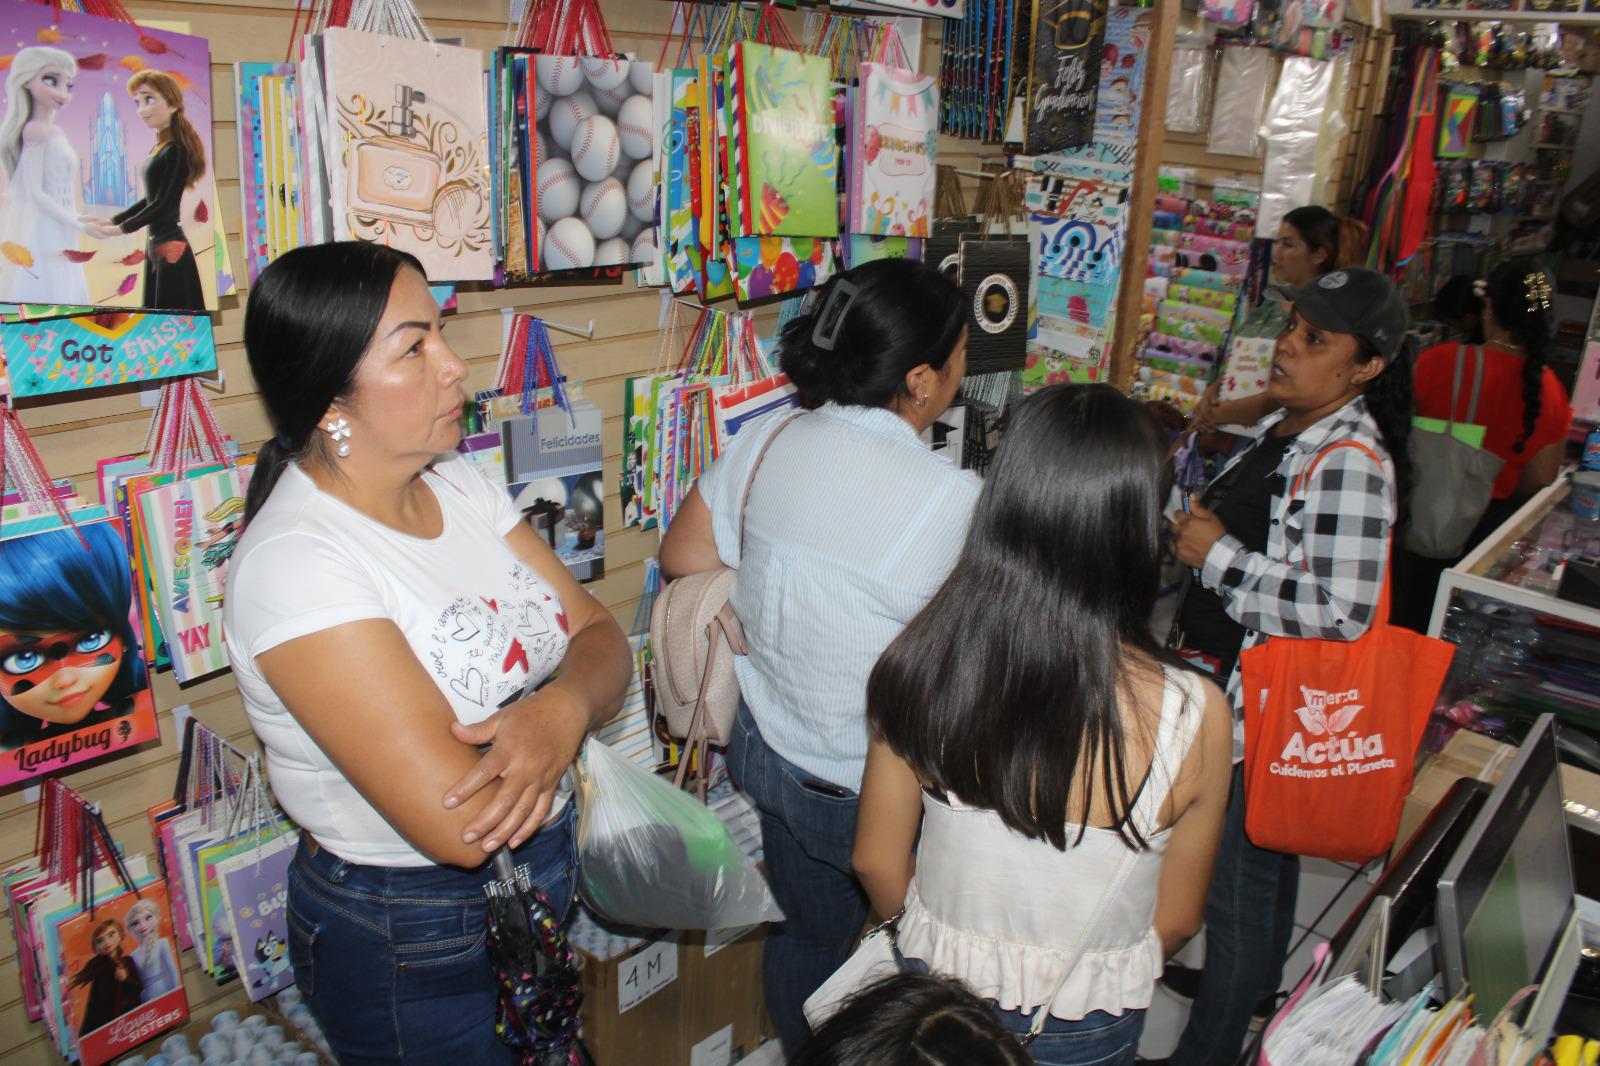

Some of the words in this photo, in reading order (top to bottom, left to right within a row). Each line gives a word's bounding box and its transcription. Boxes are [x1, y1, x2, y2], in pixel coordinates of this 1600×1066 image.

[1054, 54, 1086, 91] Feliz
[39, 328, 59, 352] I
[60, 338, 113, 364] Got
[121, 316, 185, 360] this!
[540, 433, 600, 449] Felicidades
[172, 499, 193, 613] AWESOME!
[177, 623, 210, 656] YAY
[14, 728, 112, 773] Ladybug
[1280, 731, 1384, 765] Actúa
[1269, 762, 1329, 778] Cuidemos
[1330, 764, 1345, 776] el
[1346, 758, 1396, 775] Planeta
[625, 965, 640, 987] 4
[647, 952, 661, 980] M
[107, 1007, 158, 1045] Love
[128, 1007, 182, 1043] SISTERS
